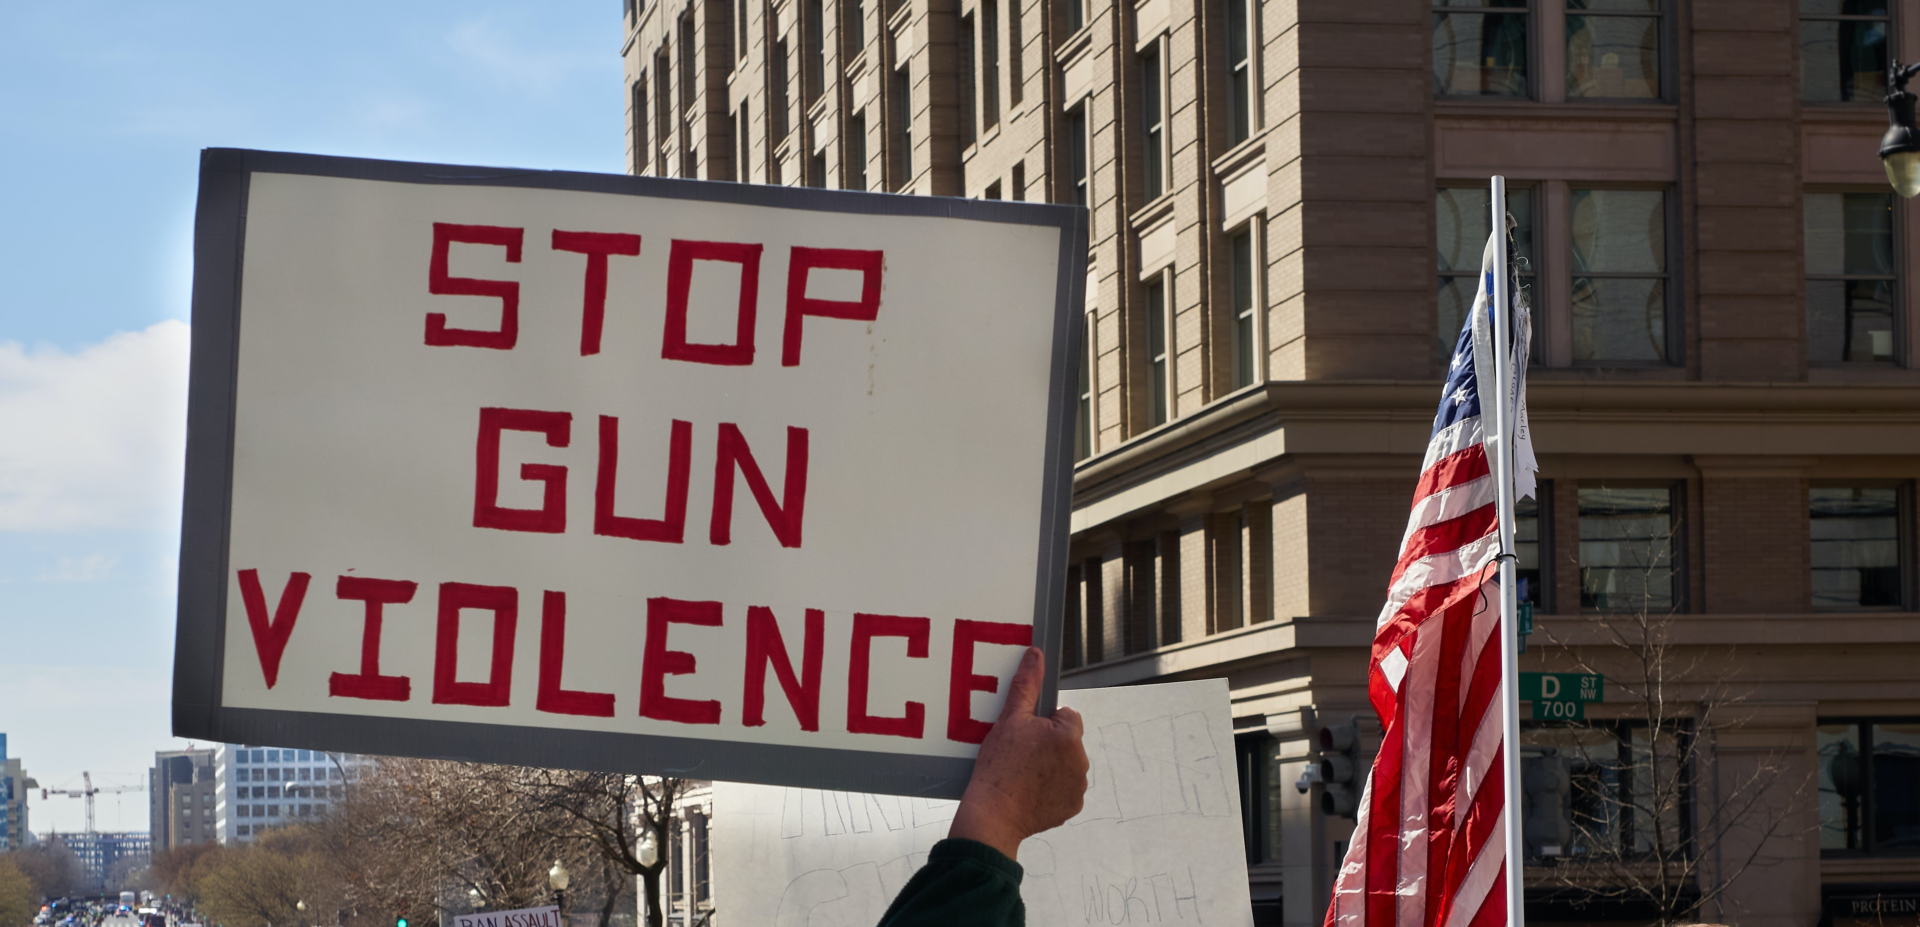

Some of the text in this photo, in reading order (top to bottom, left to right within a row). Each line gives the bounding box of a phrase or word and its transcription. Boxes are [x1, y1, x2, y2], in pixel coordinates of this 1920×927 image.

[425, 222, 883, 367] STOP
[1516, 399, 1527, 440] Marley
[473, 408, 809, 547] GUN
[238, 568, 1033, 745] VIOLENCE
[1541, 675, 1597, 698] D ST
[1580, 689, 1597, 700] NW
[1541, 701, 1576, 717] 700
[1081, 866, 1201, 925] WORTH
[1852, 899, 1916, 913] PROTEIN
[505, 909, 559, 927] ASSAULT
